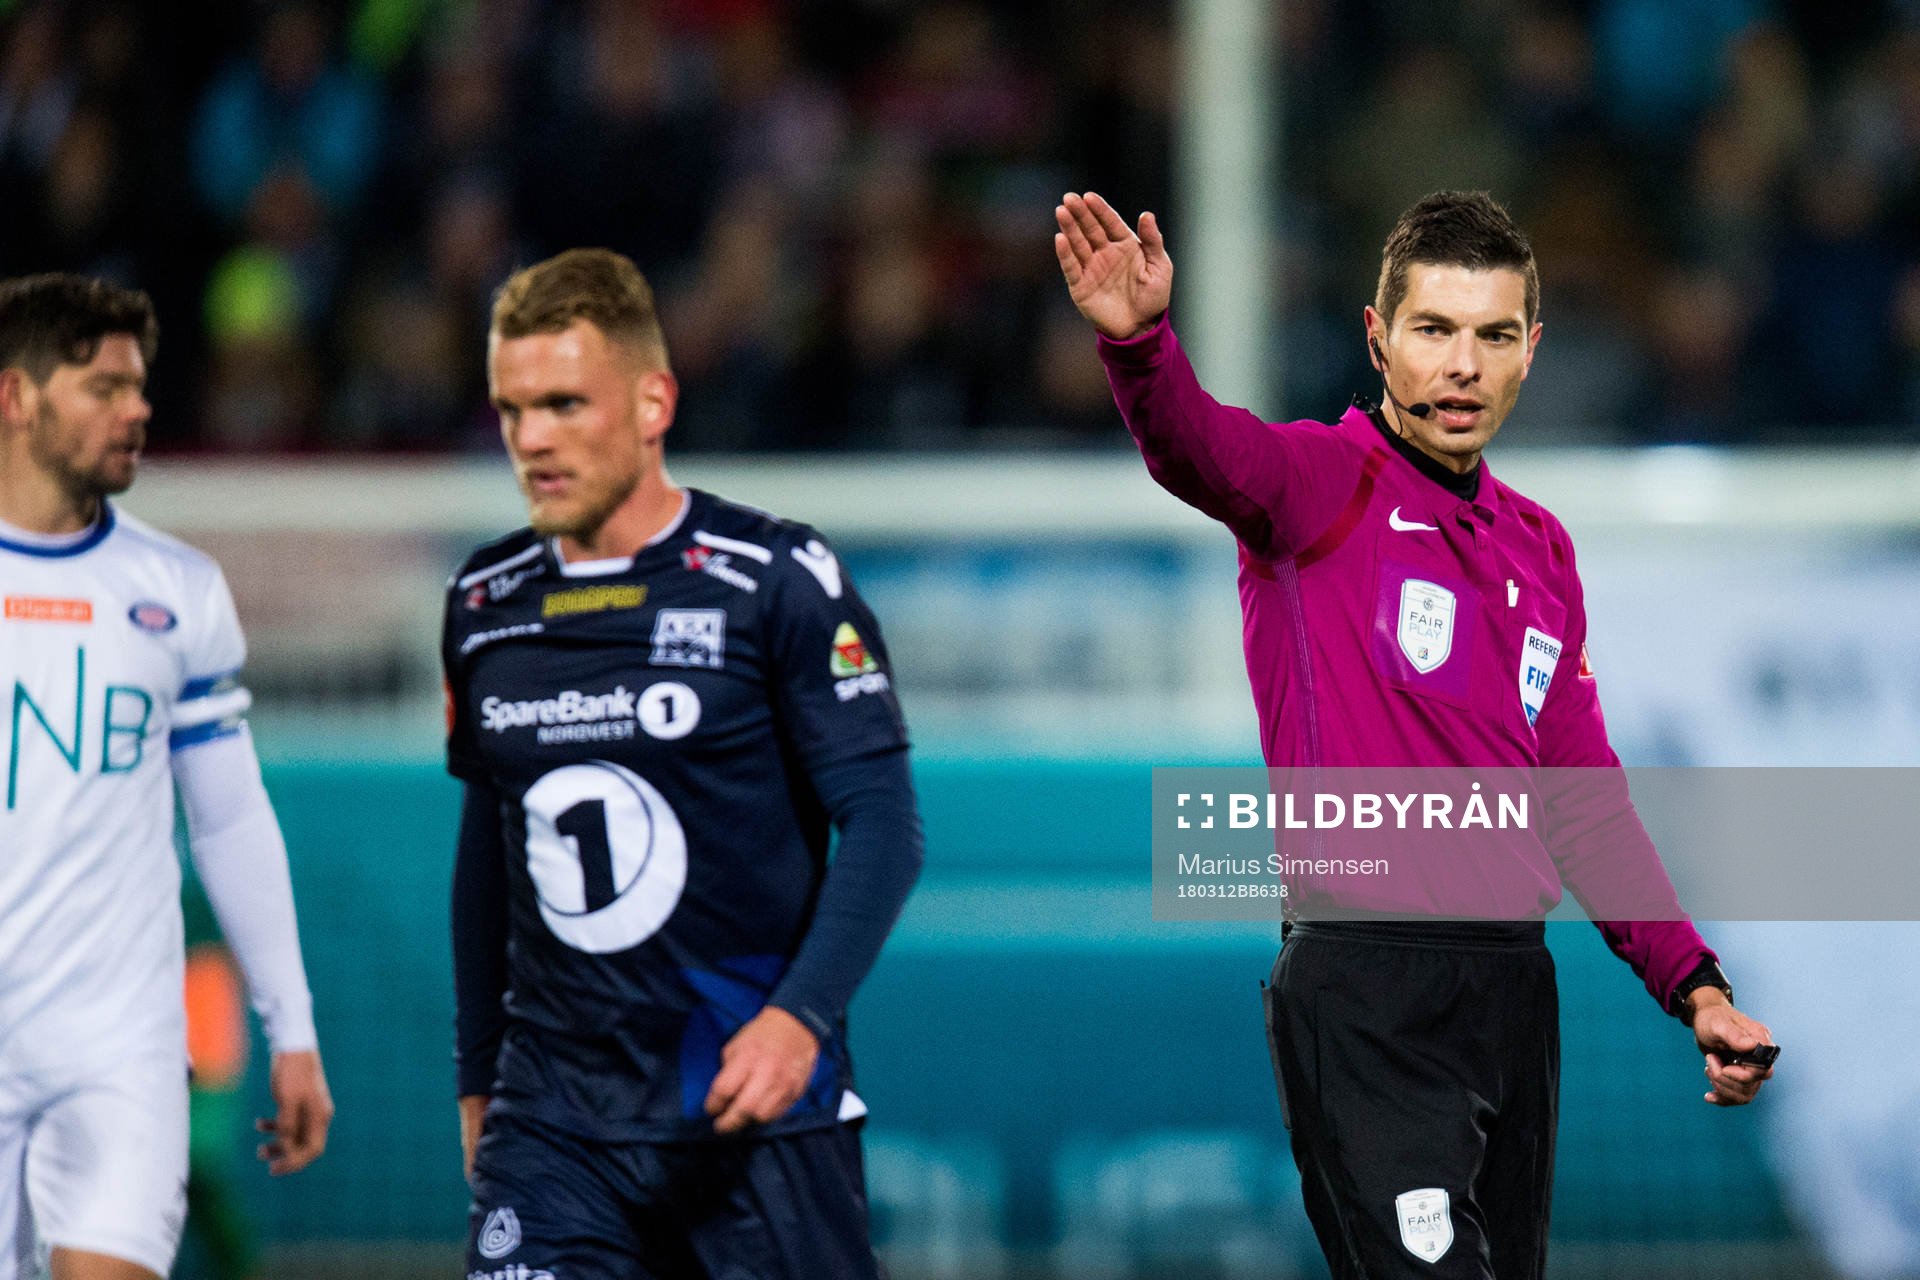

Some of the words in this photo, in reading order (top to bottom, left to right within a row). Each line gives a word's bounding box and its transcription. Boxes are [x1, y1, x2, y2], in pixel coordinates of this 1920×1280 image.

[1410, 611, 1443, 630] FAIR
[1408, 622, 1441, 640] PLAY
[481, 685, 635, 733] SpareBank
[538, 721, 636, 743] NORDVEST
[1408, 1212, 1441, 1226] FAIR
